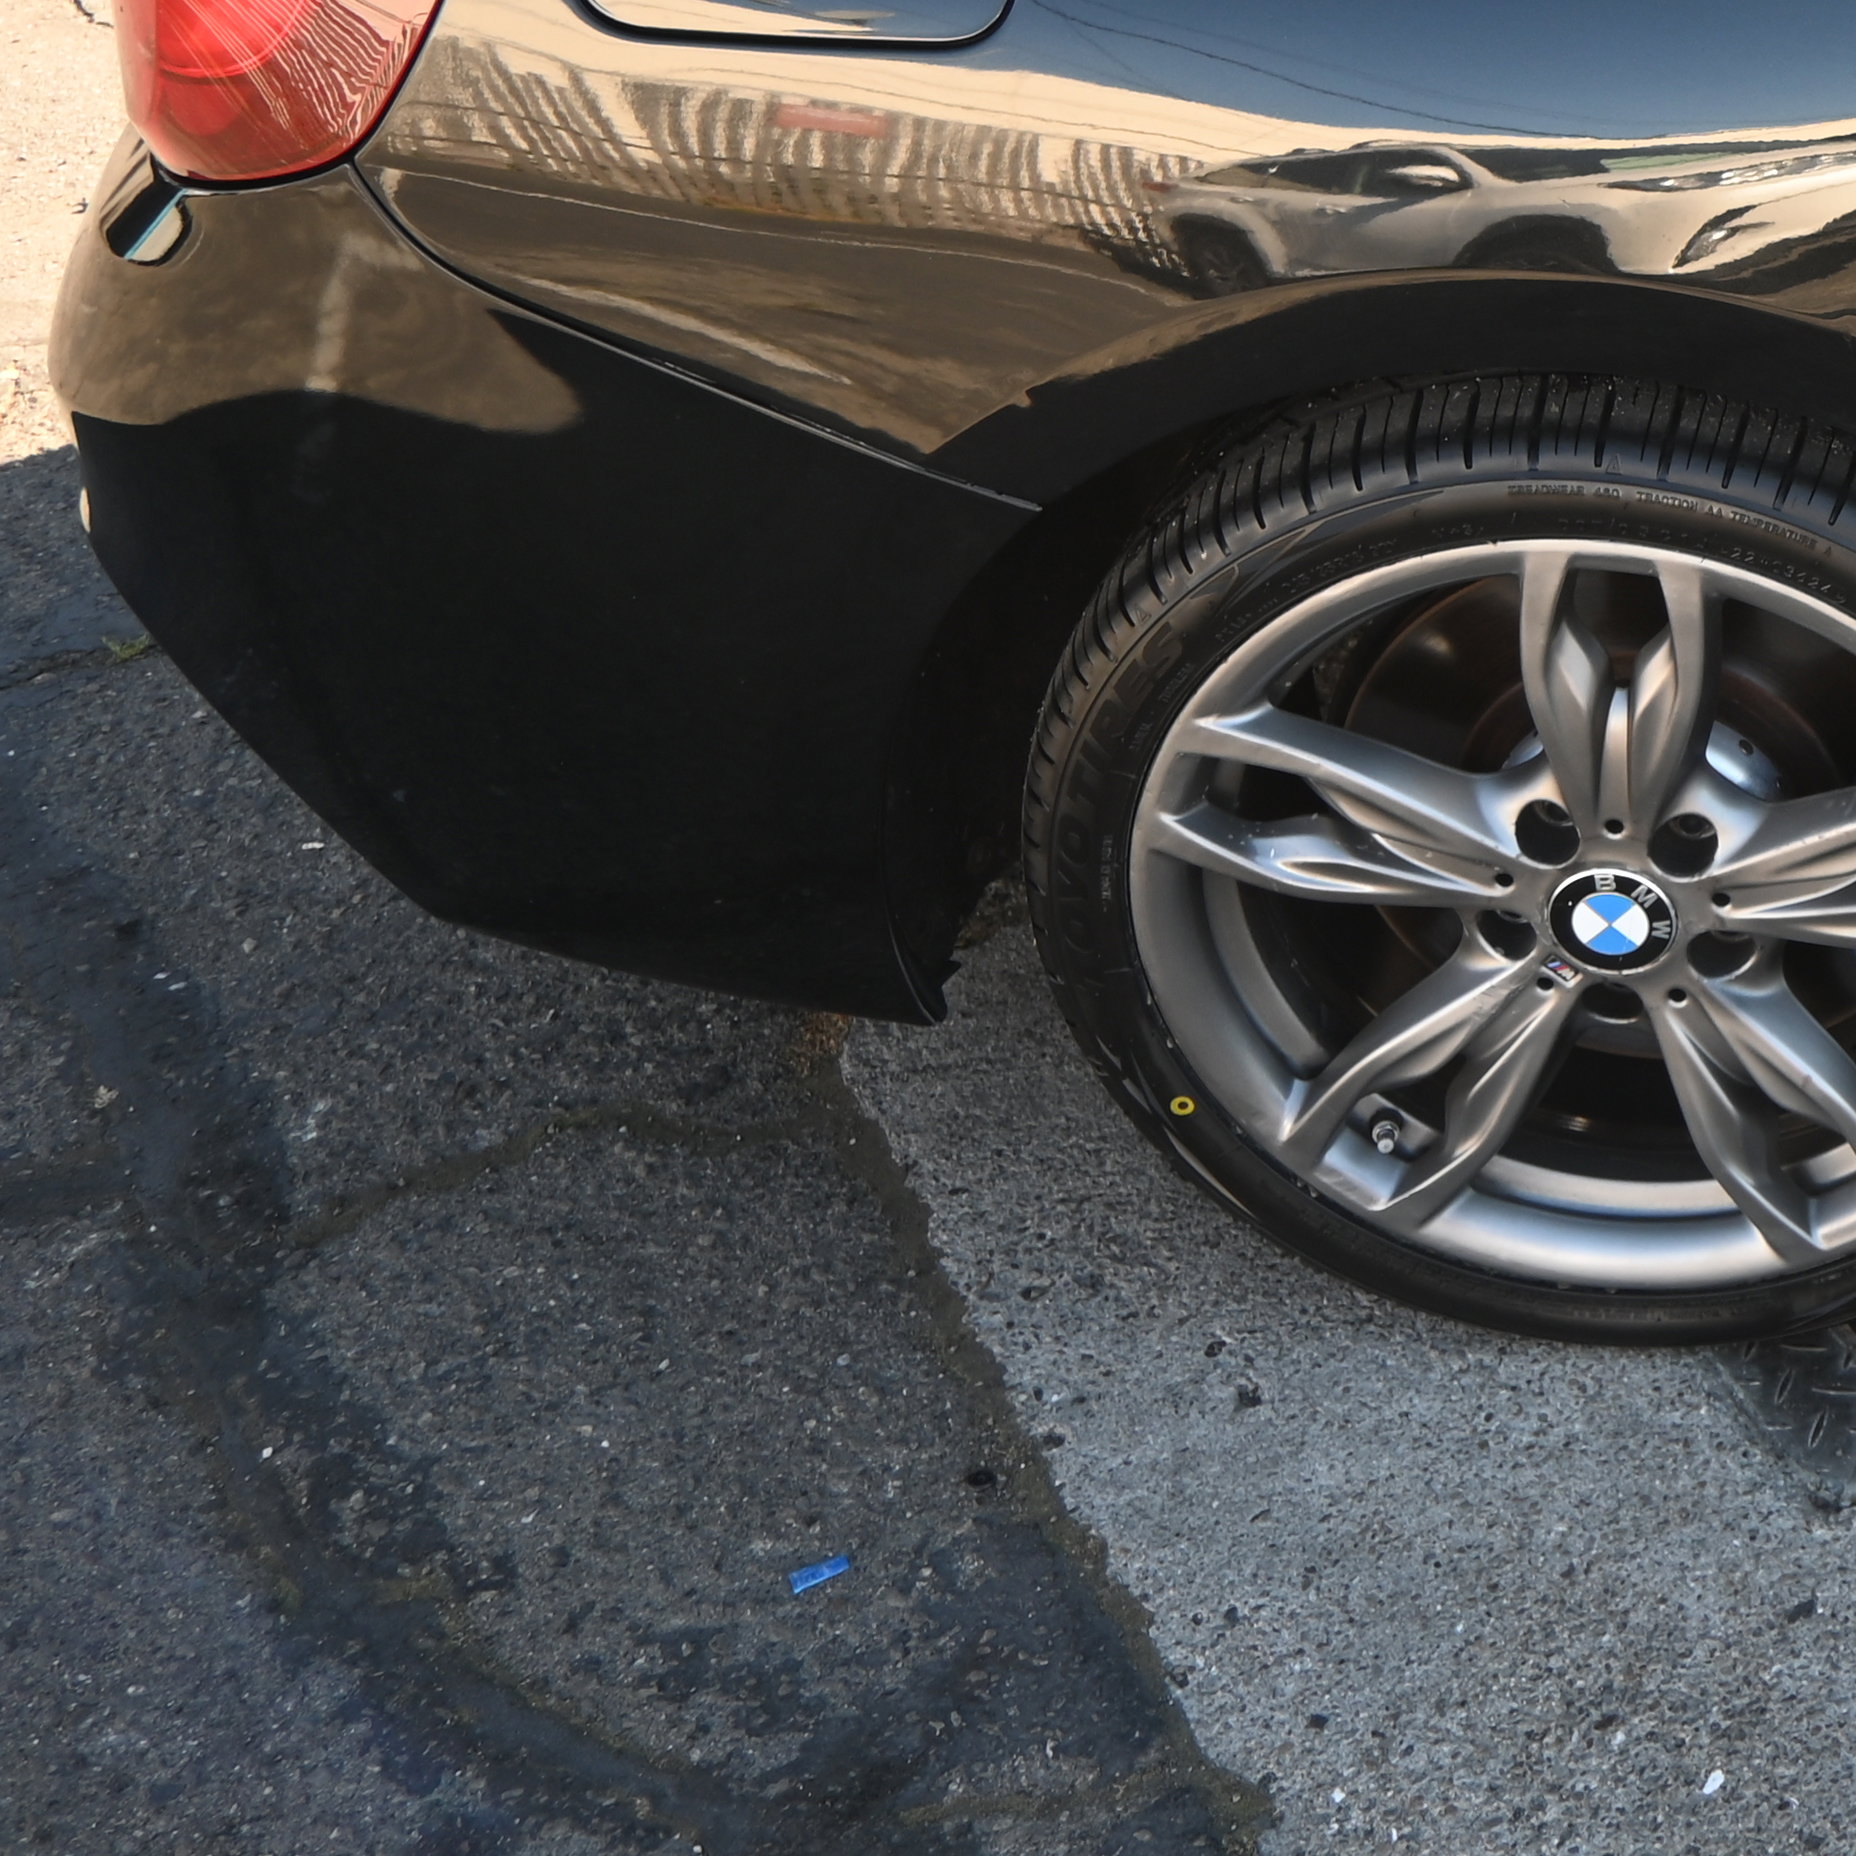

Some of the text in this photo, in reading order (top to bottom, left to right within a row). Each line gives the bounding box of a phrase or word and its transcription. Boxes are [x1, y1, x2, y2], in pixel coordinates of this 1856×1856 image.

[1636, 490, 1699, 512] TRACTION
[1731, 510, 1819, 550] TEMPERATURE
[1066, 620, 1183, 804] TIRES
[1593, 873, 1672, 940] BMW
